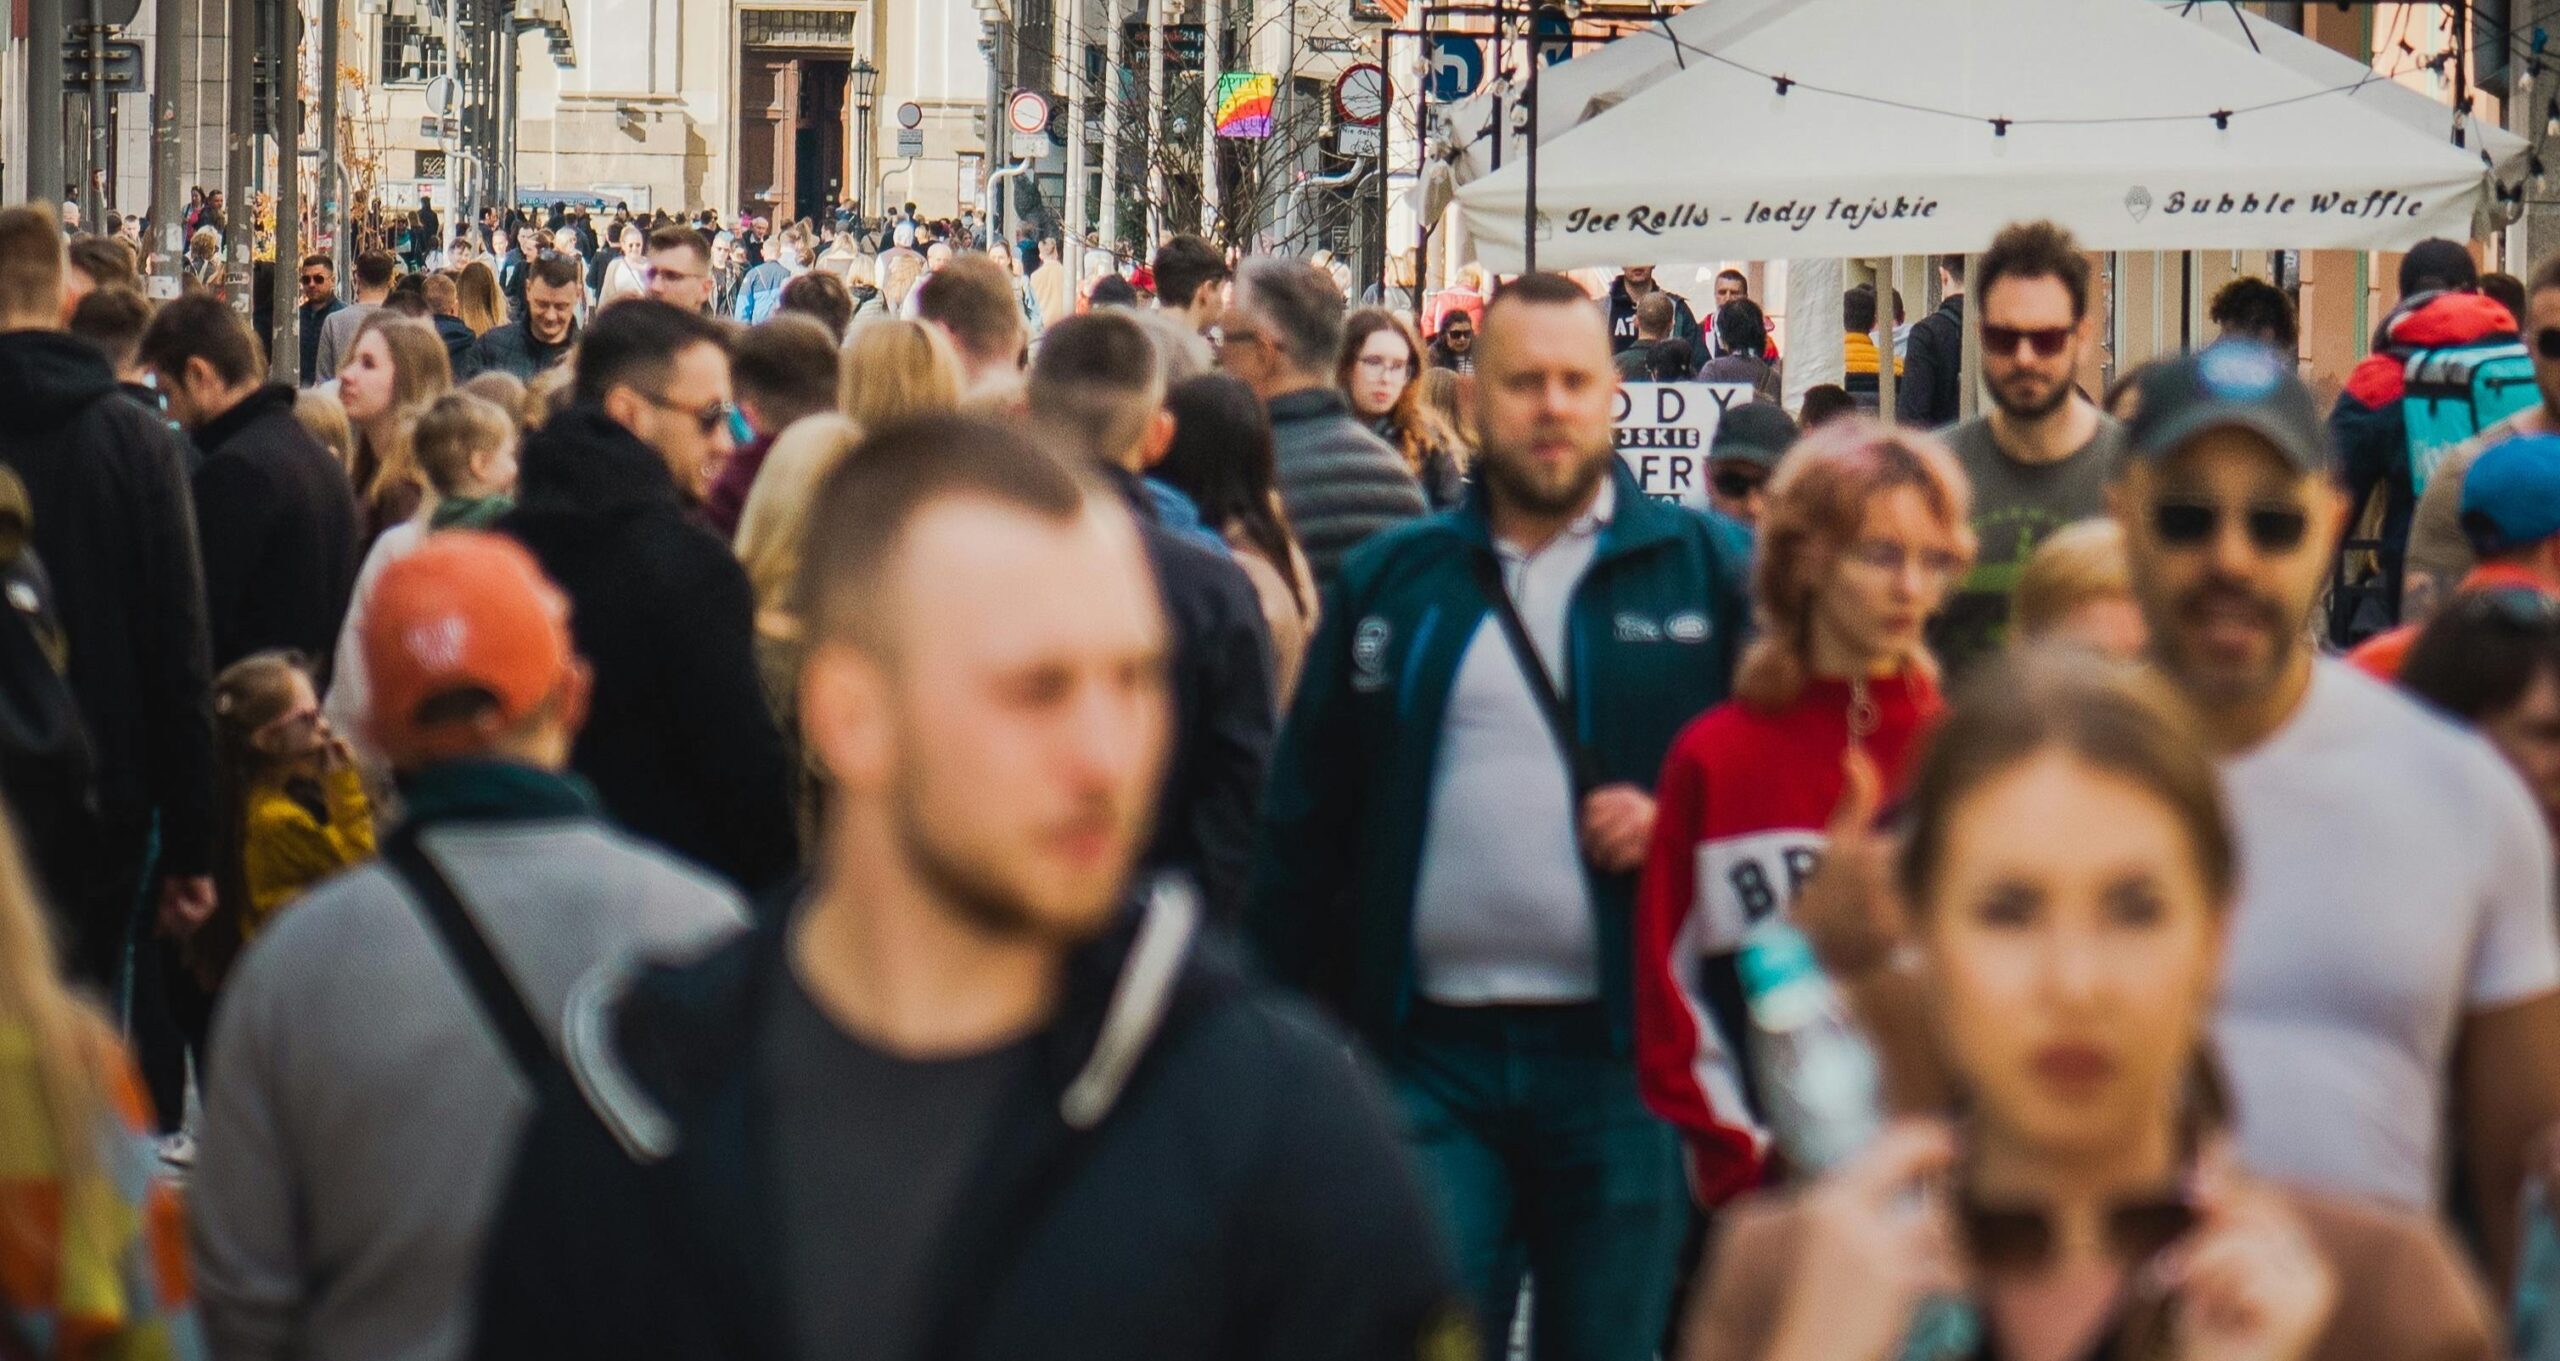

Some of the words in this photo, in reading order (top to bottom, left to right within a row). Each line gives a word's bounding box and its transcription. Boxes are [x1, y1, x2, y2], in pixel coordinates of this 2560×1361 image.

[1566, 206, 1620, 233] Ice
[1627, 204, 1709, 236] Rolls
[1744, 200, 1817, 232] lody
[1826, 196, 1939, 230] tajskie
[2163, 191, 2296, 214] Bubble
[2310, 190, 2423, 218] Waffle
[1614, 316, 1637, 336] AT
[1610, 428, 1698, 446] JSKIE
